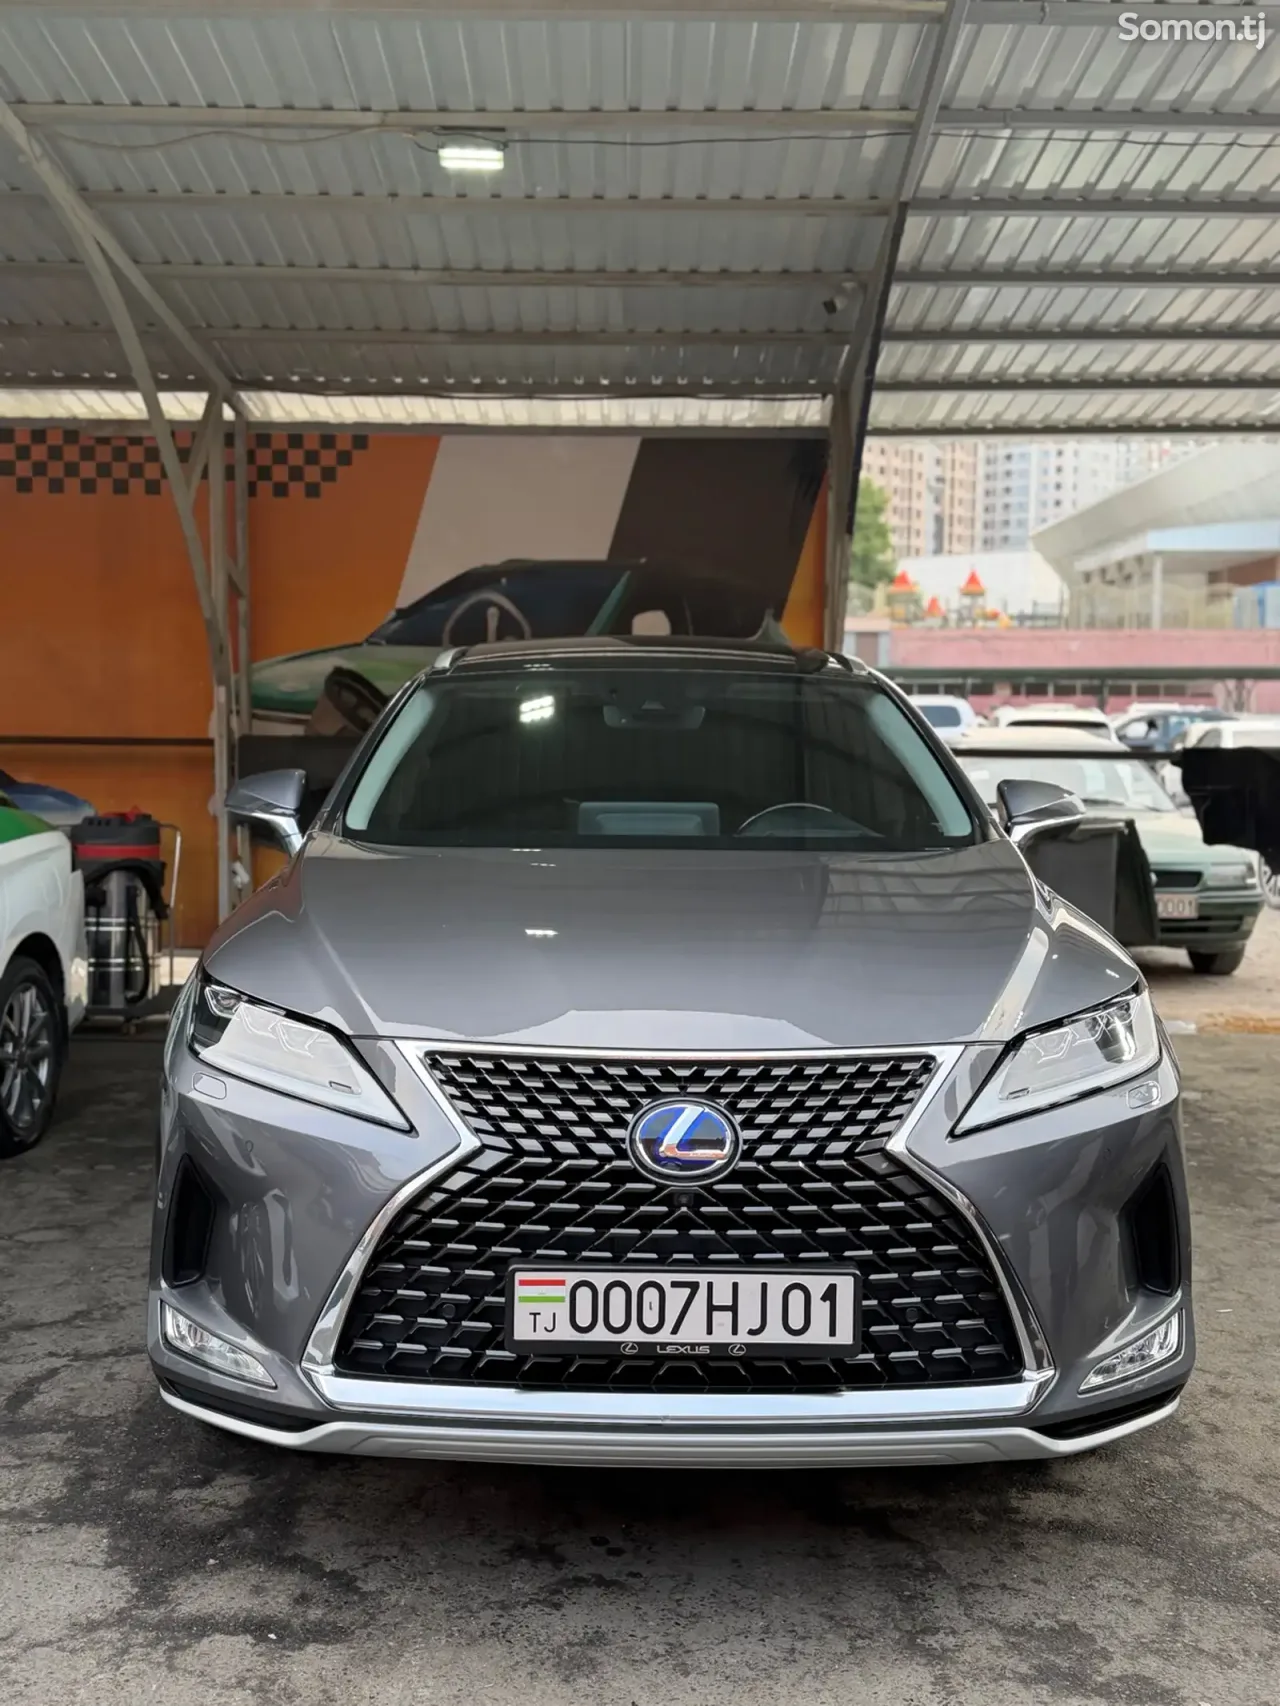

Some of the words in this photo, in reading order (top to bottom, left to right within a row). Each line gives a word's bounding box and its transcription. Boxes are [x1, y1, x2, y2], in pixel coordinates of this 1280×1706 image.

[569, 1280, 838, 1337] 0007HJ01
[529, 1312, 556, 1333] TJ
[656, 1345, 710, 1354] LEXUS
